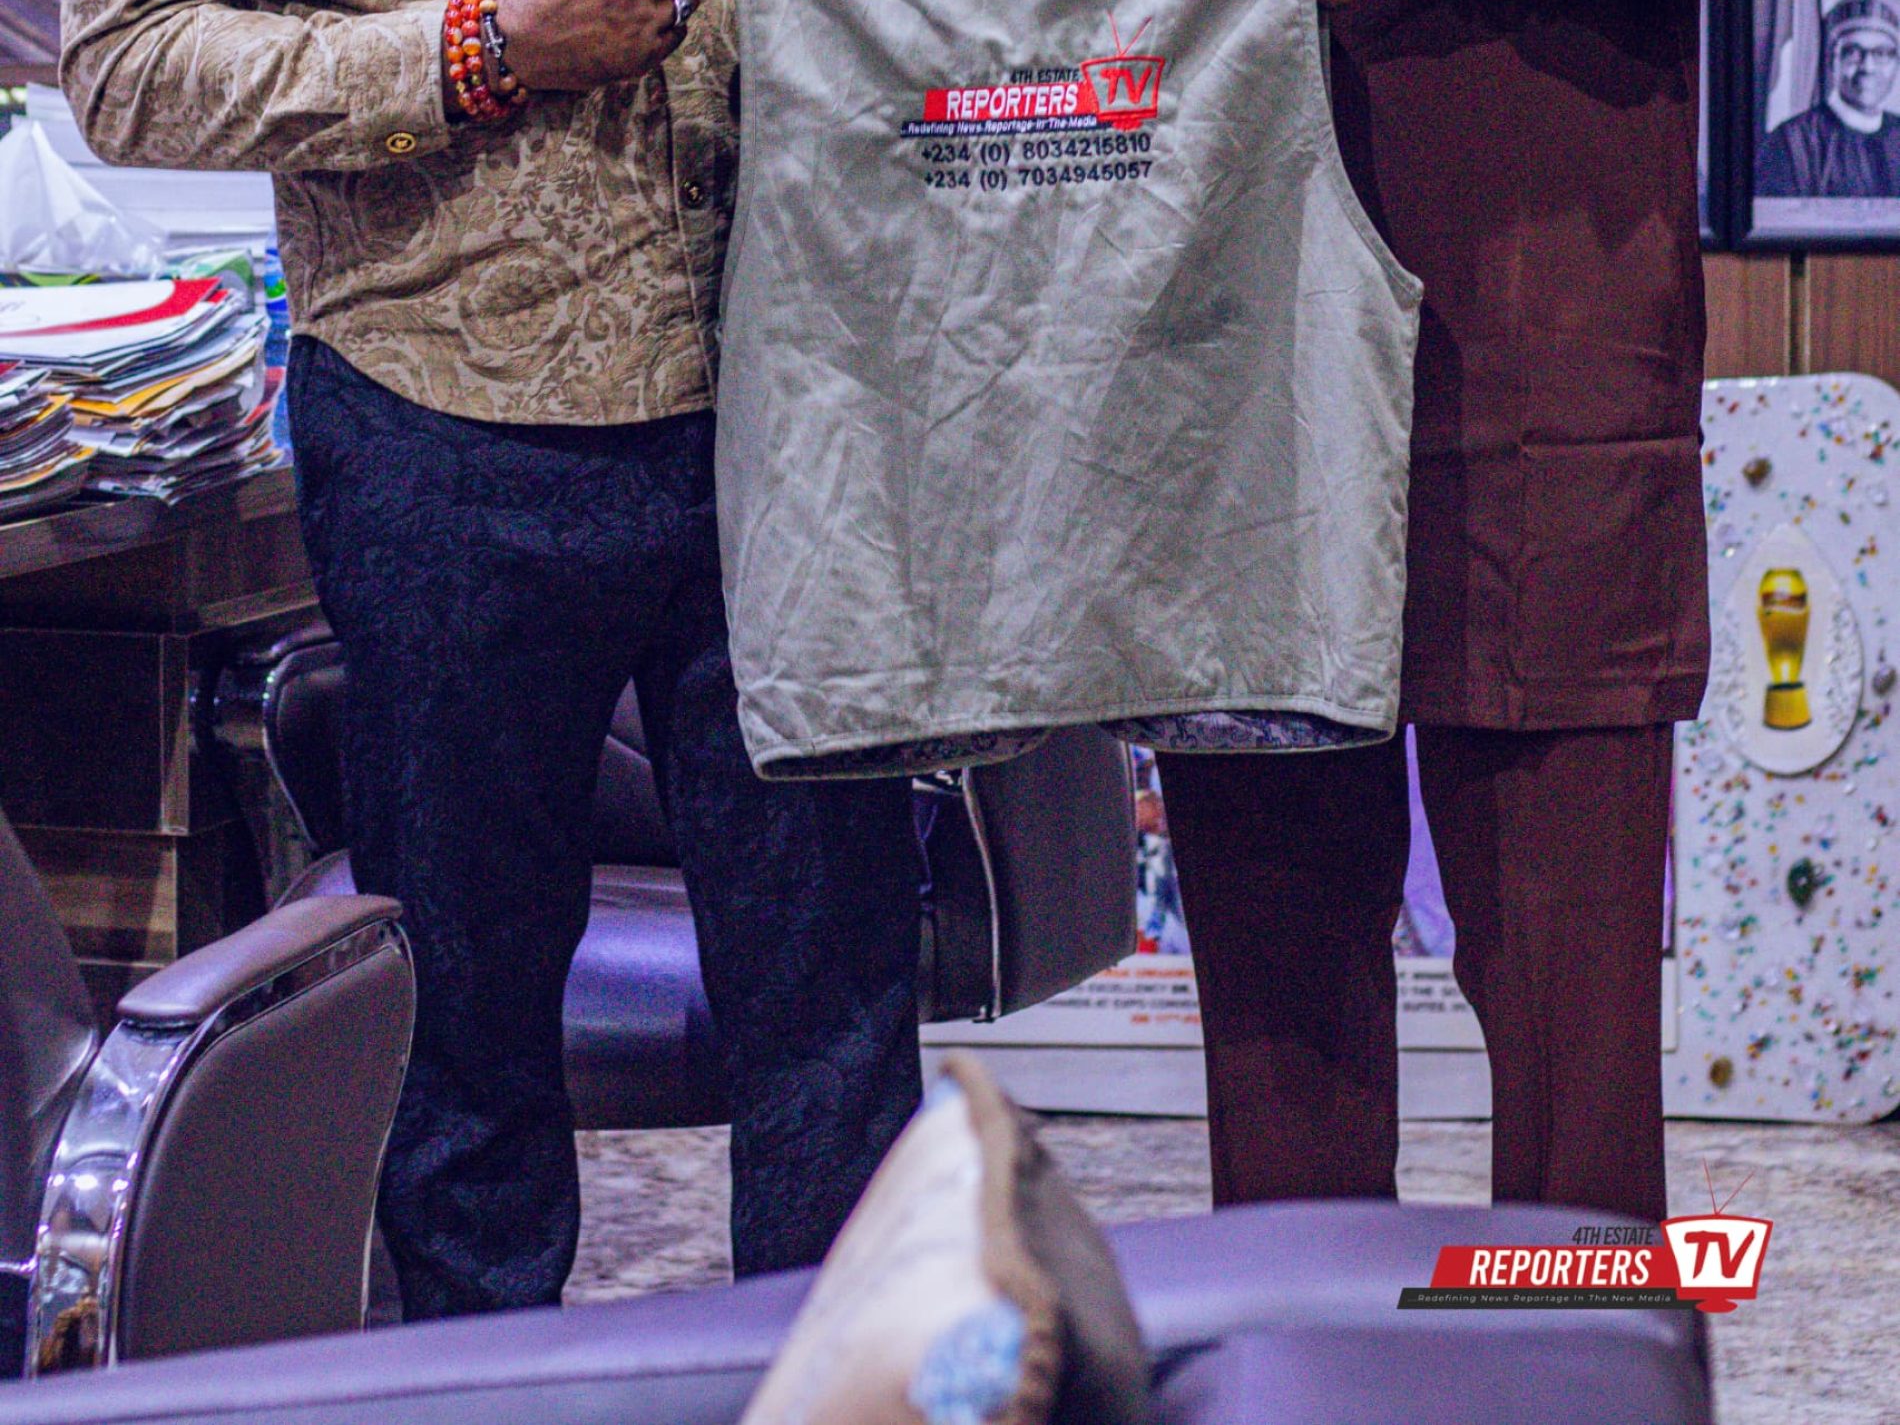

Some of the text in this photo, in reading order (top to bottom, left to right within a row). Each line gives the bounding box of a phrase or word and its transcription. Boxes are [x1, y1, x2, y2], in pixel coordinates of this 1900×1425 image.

[1010, 66, 1080, 83] 4TH ESTATE
[1101, 68, 1152, 106] TV
[947, 84, 1079, 120] REPORTERS
[957, 121, 982, 133] News
[985, 118, 1033, 134] Reportage
[1048, 117, 1067, 129] The
[1068, 114, 1097, 127] Media
[922, 133, 1151, 165] +234 (0) 8034215810
[924, 161, 1152, 191] +234 (0) 7034945057
